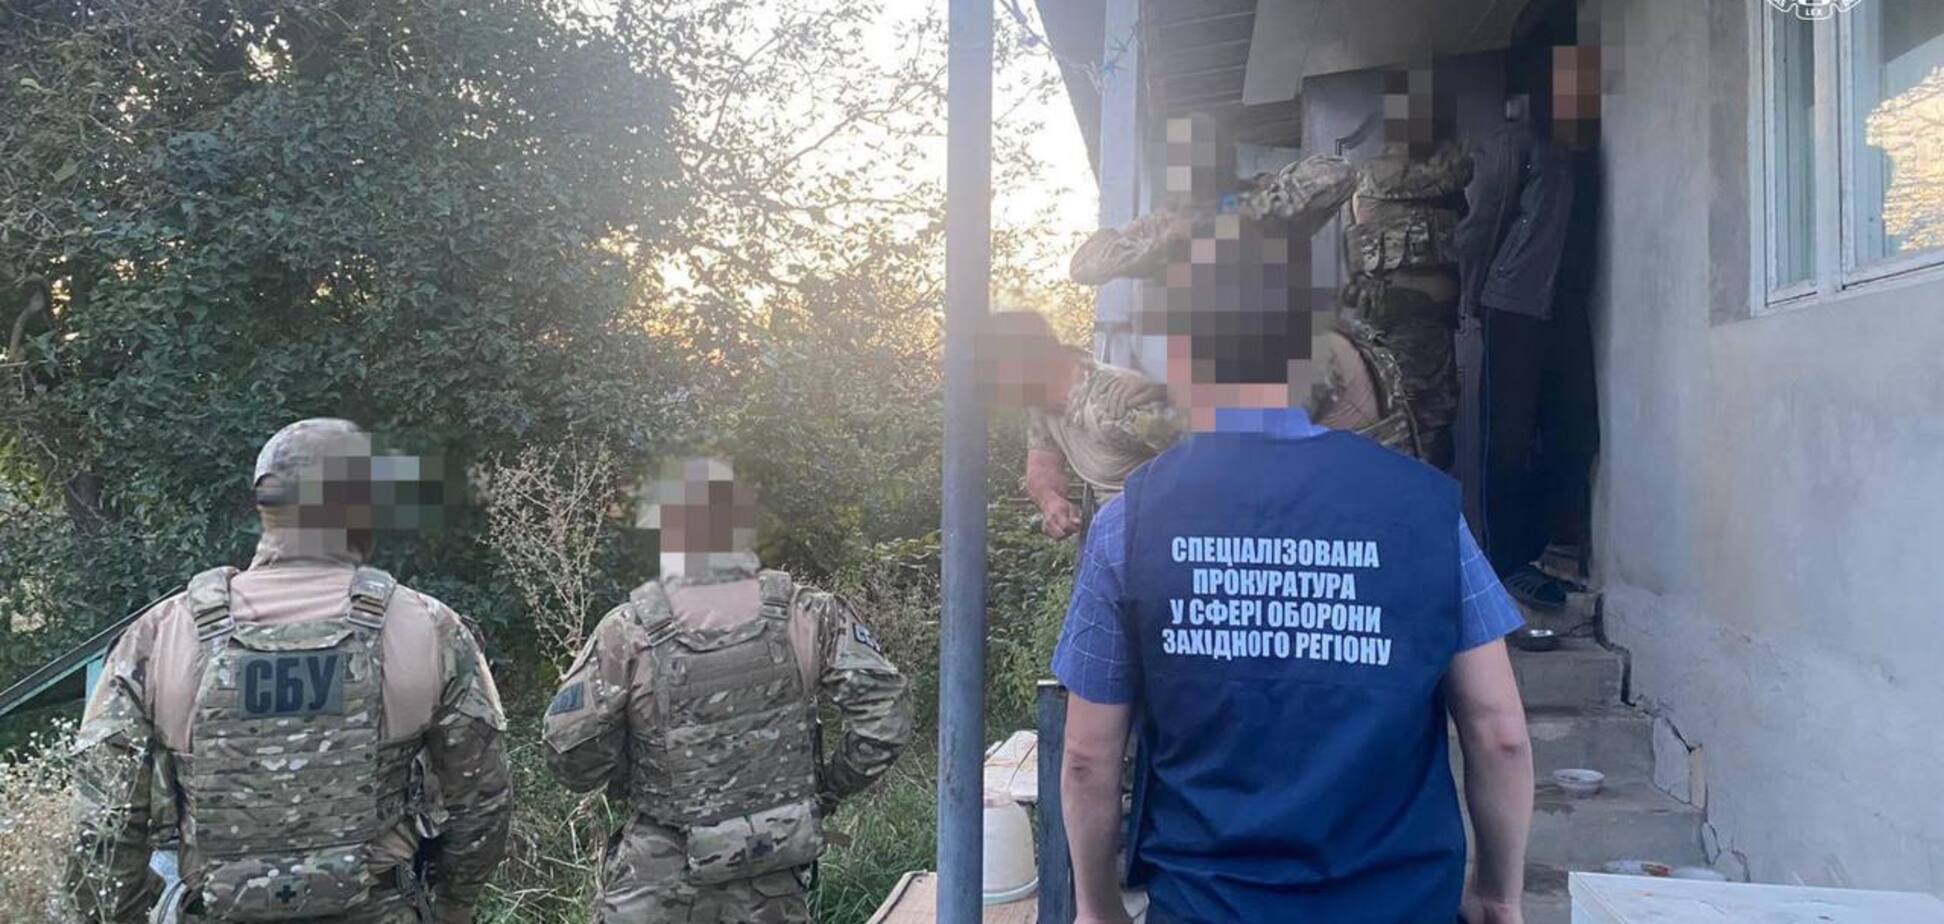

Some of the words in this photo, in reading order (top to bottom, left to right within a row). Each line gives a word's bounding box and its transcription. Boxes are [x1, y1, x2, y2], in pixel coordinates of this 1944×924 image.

[1172, 536, 1380, 568] СПЕЦІАЛІЗОВАНА
[1193, 568, 1356, 600] ПРОКУРАТУРА
[1170, 599, 1184, 625] У
[1189, 599, 1262, 626] СФЕРІ
[1268, 601, 1381, 633] ОБОРОНИ
[1162, 628, 1290, 661] ЗАХІДНОГО
[1295, 632, 1392, 667] РЕГІОНУ
[244, 654, 339, 714] СБУ
